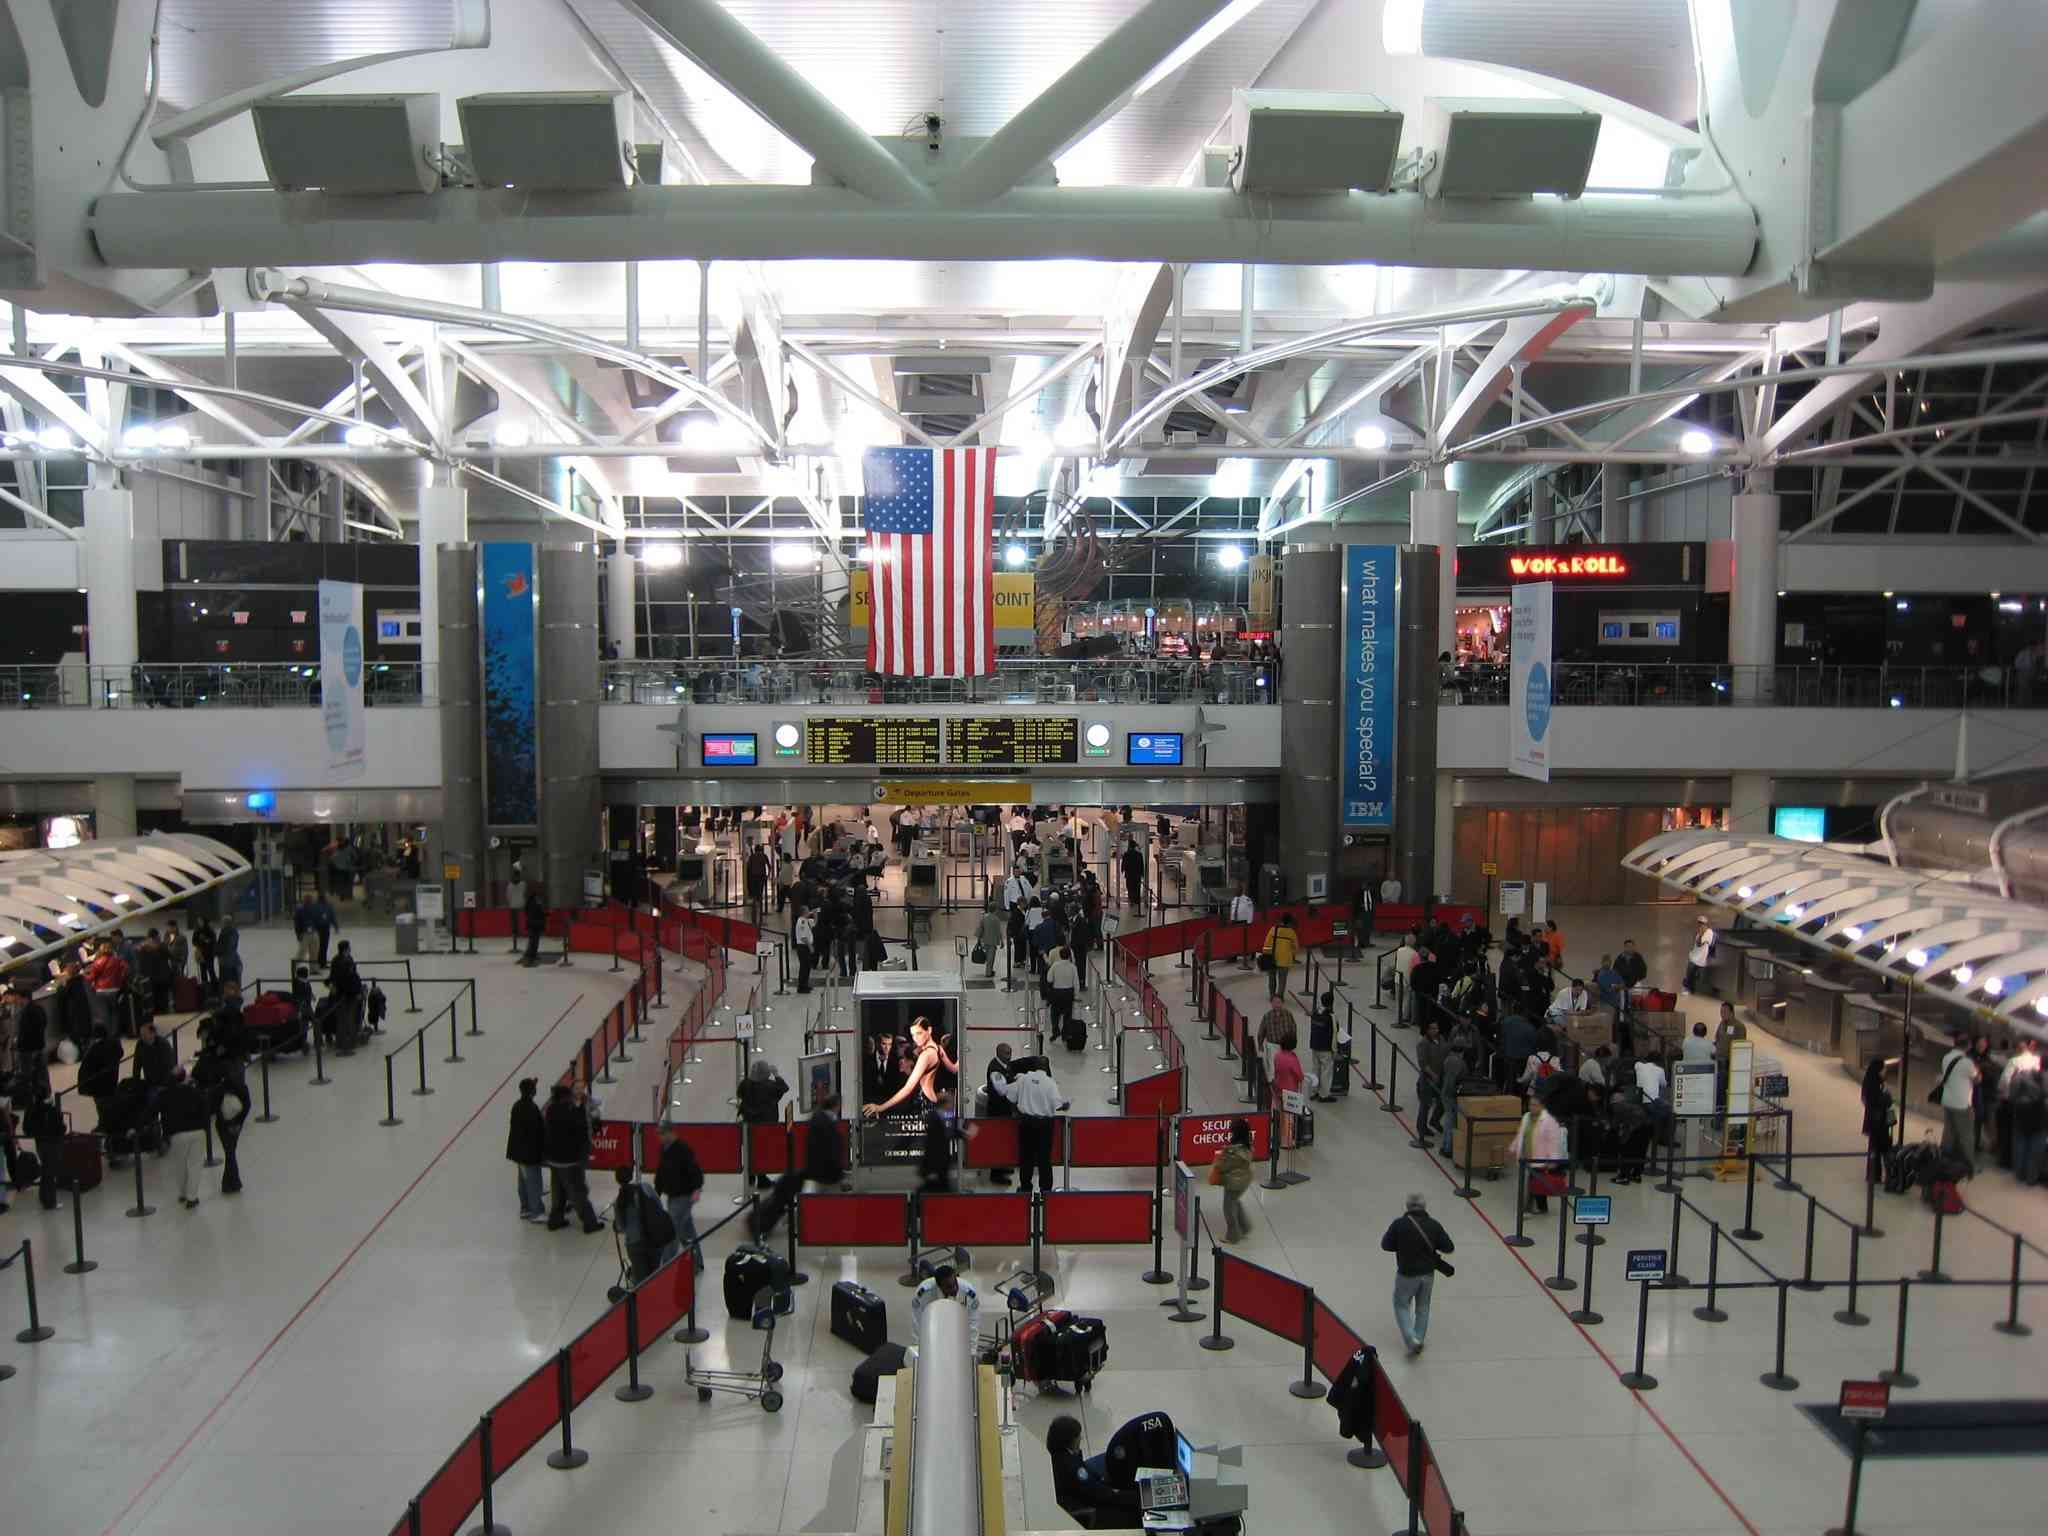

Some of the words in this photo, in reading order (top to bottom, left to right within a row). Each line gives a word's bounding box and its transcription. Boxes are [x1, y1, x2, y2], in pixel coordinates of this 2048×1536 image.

[1510, 557, 1557, 574] WOK
[1361, 560, 1380, 606] what
[1360, 611, 1377, 673] makes
[1355, 677, 1374, 713] you
[1355, 717, 1377, 791] special?
[904, 789, 946, 798] Departure
[946, 789, 971, 797] Gates
[1348, 802, 1384, 817] IBM
[1142, 1417, 1163, 1432] TSA
